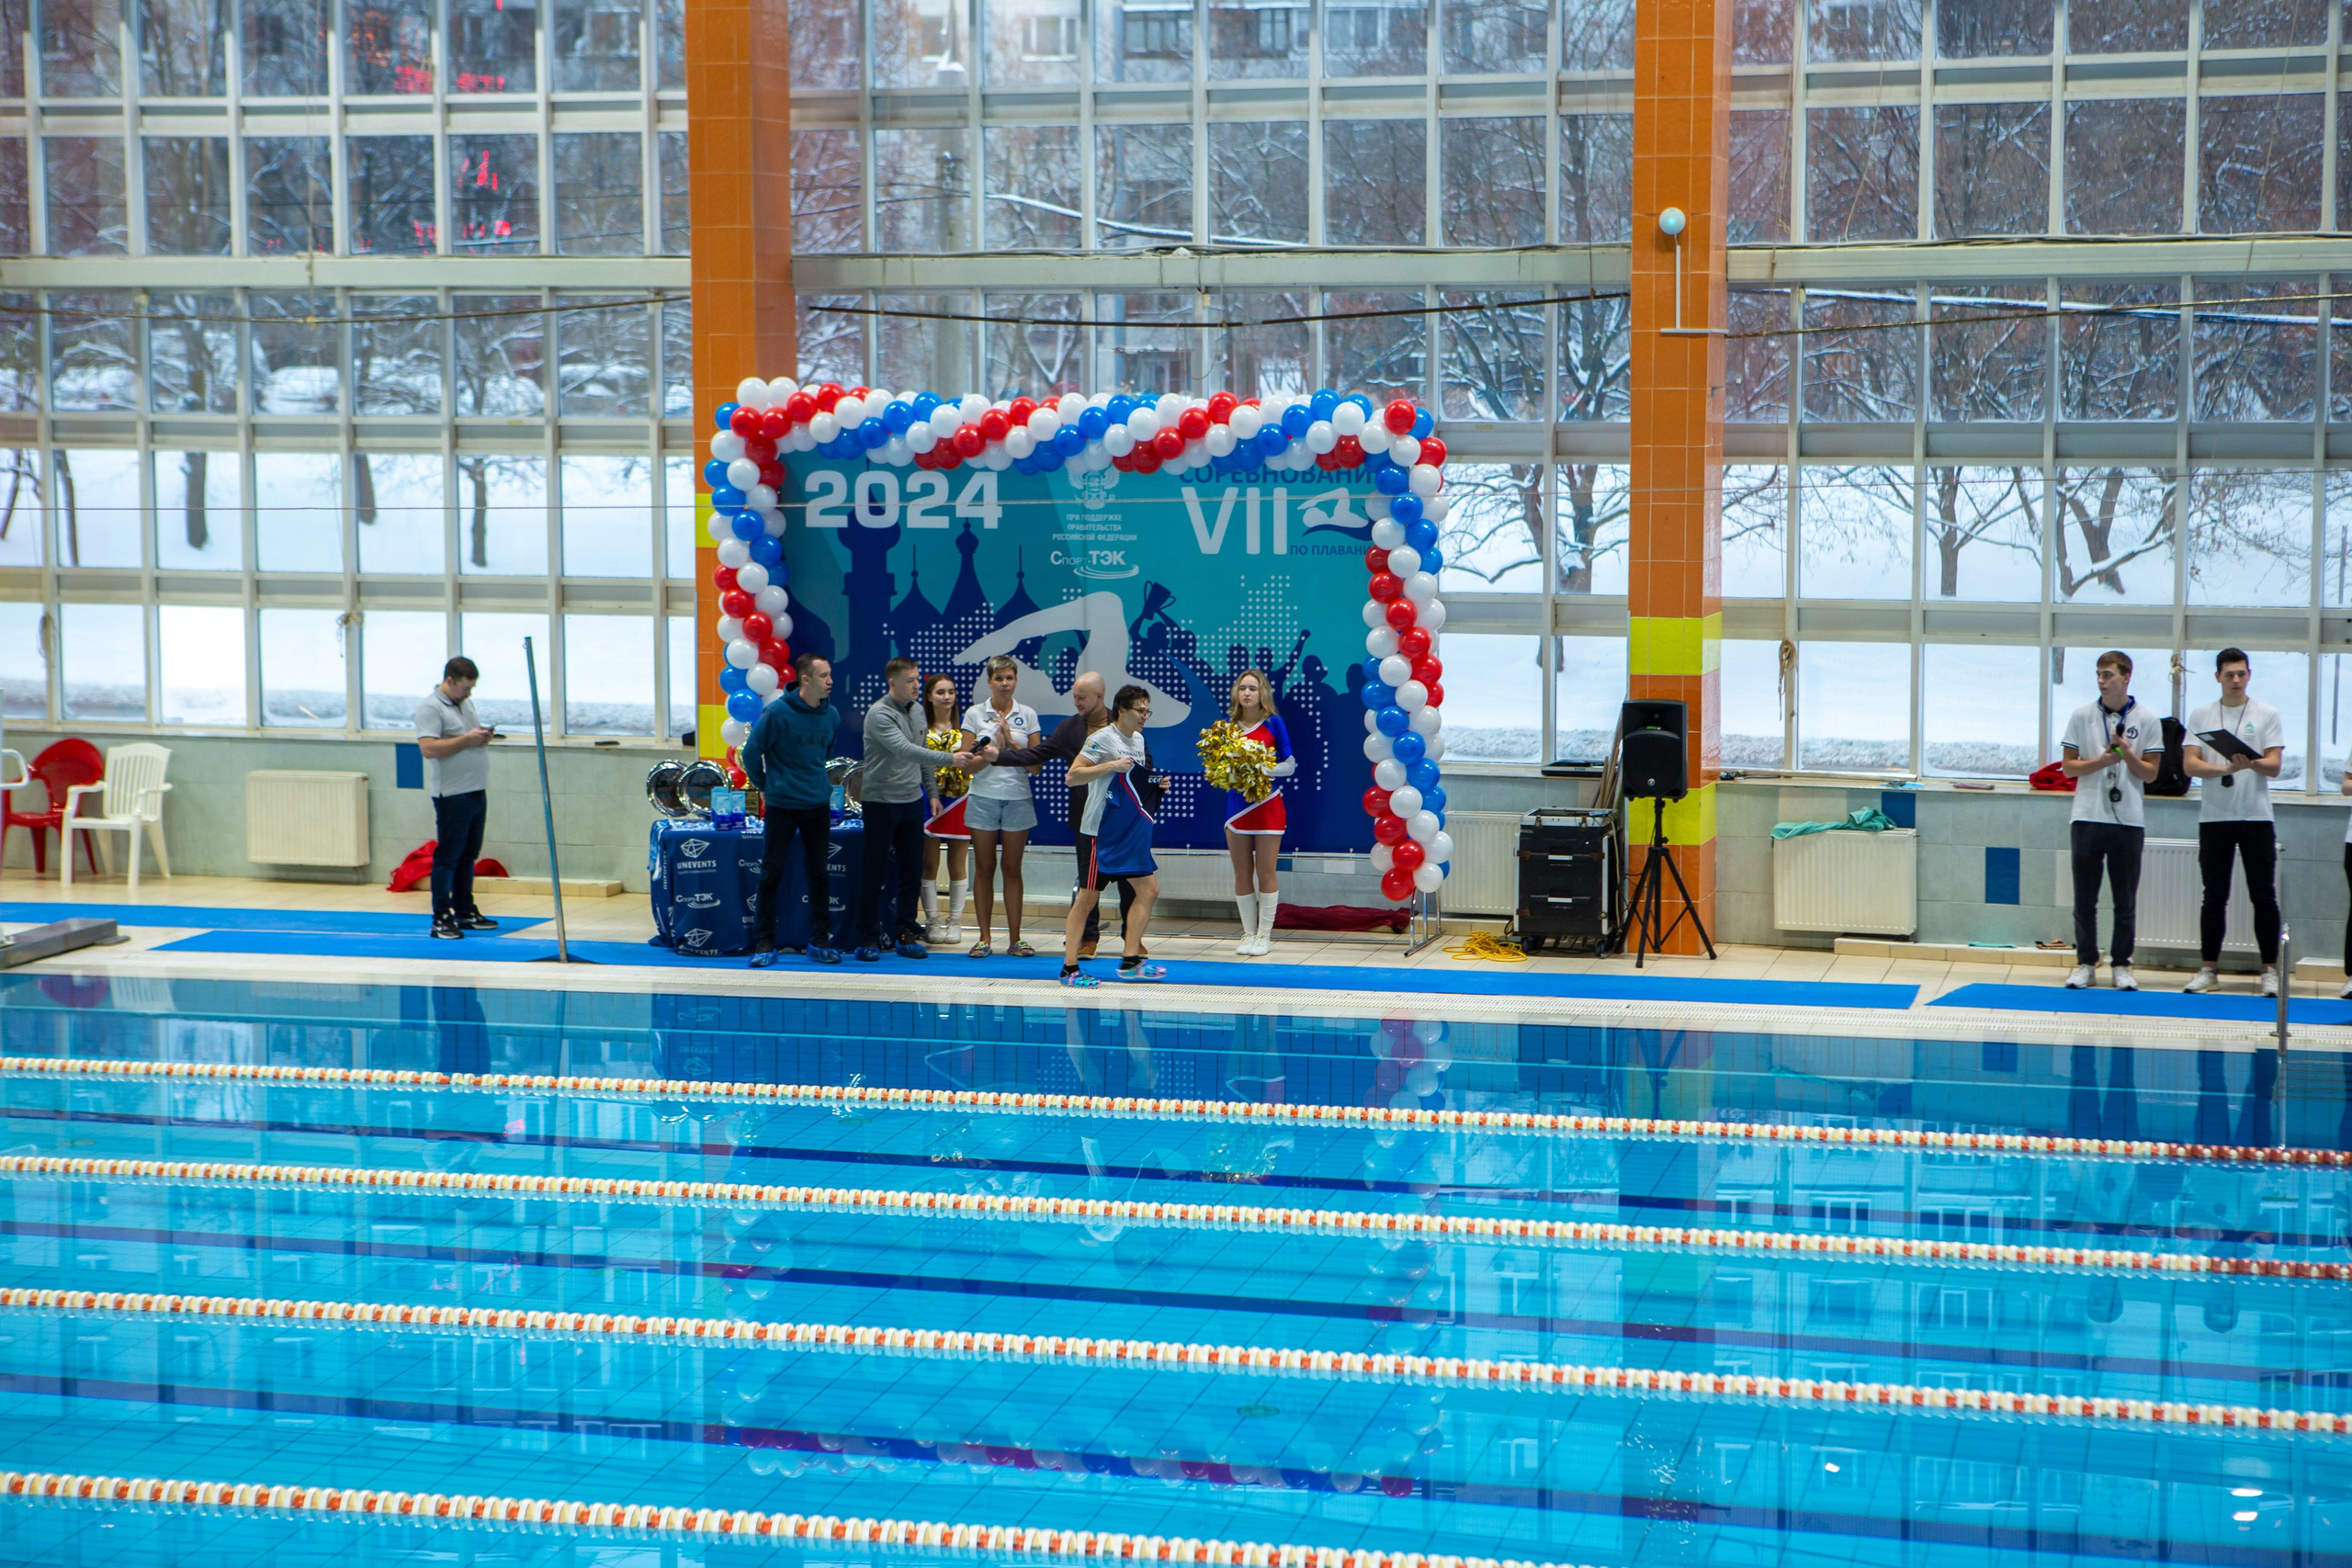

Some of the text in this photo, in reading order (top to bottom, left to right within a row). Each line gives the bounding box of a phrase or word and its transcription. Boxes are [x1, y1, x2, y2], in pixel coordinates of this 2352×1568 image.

[805, 470, 1002, 529] 2024
[1181, 487, 1287, 555] VII
[1290, 545, 1307, 555] ПО
[676, 860, 717, 869] UNEVENTS
[827, 863, 846, 872] ENTS
